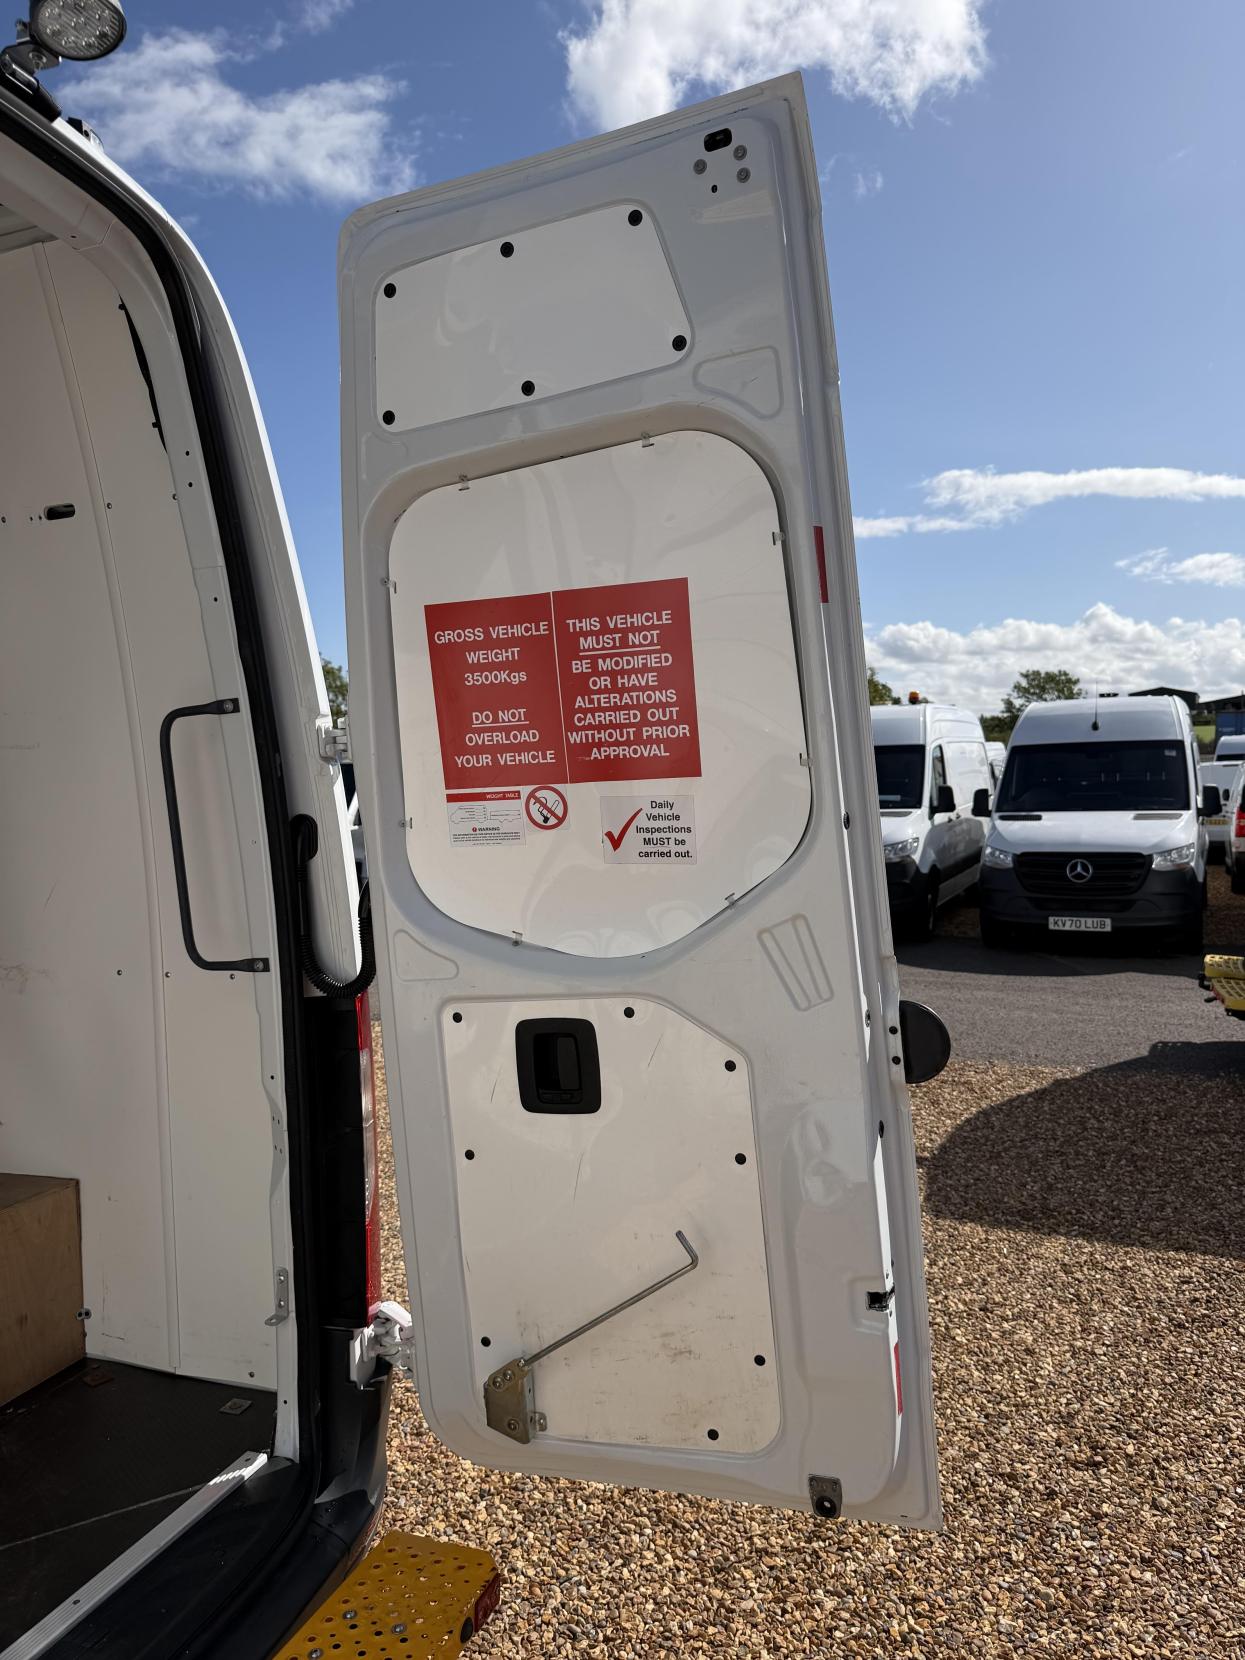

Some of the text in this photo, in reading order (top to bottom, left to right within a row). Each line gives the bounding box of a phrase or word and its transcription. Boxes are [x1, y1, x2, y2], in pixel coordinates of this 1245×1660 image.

[566, 610, 672, 633] THIS VEHICLE
[434, 621, 549, 644] GROSS VEHICLE
[579, 630, 660, 650] MUST NOT
[465, 648, 520, 664] WEIGHT
[572, 653, 673, 673] BE MODIFIED
[464, 670, 527, 686] 3500Kgs
[589, 672, 658, 690] OR HAVE
[574, 689, 677, 708] ALTERATIONS
[472, 708, 527, 724] DO NOT
[574, 707, 680, 726] CARRIED OUT
[465, 729, 539, 746] OVERLOAD
[567, 724, 690, 744] WITHOUT PRIOR
[455, 750, 556, 768] YOUR VEHICLE
[590, 744, 670, 760] APPROVAL
[650, 800, 674, 811] Daily
[645, 812, 681, 821] Vehicle
[635, 825, 692, 835] Inspections
[643, 837, 686, 846] MUST be
[638, 849, 693, 858] carried out.
[1052, 918, 1106, 929] KV70 LUB
